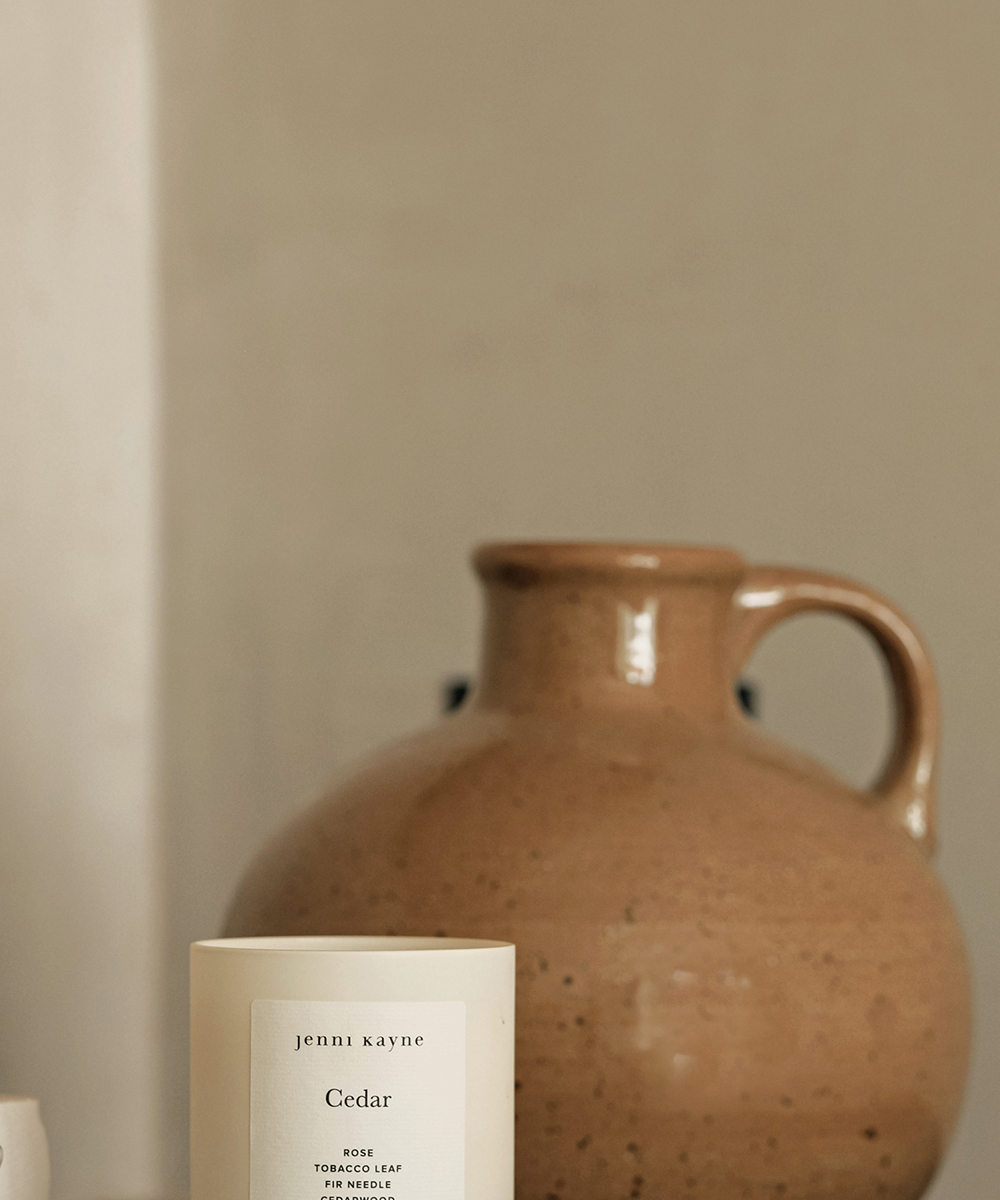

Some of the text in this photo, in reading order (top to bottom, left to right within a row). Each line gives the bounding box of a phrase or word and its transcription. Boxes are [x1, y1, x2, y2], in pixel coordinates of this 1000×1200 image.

[325, 1088, 392, 1108] Cedar
[343, 1148, 374, 1158] ROSE
[313, 1163, 402, 1173] TOBACCO LEAF
[324, 1179, 392, 1189] FIR NEEDLE
